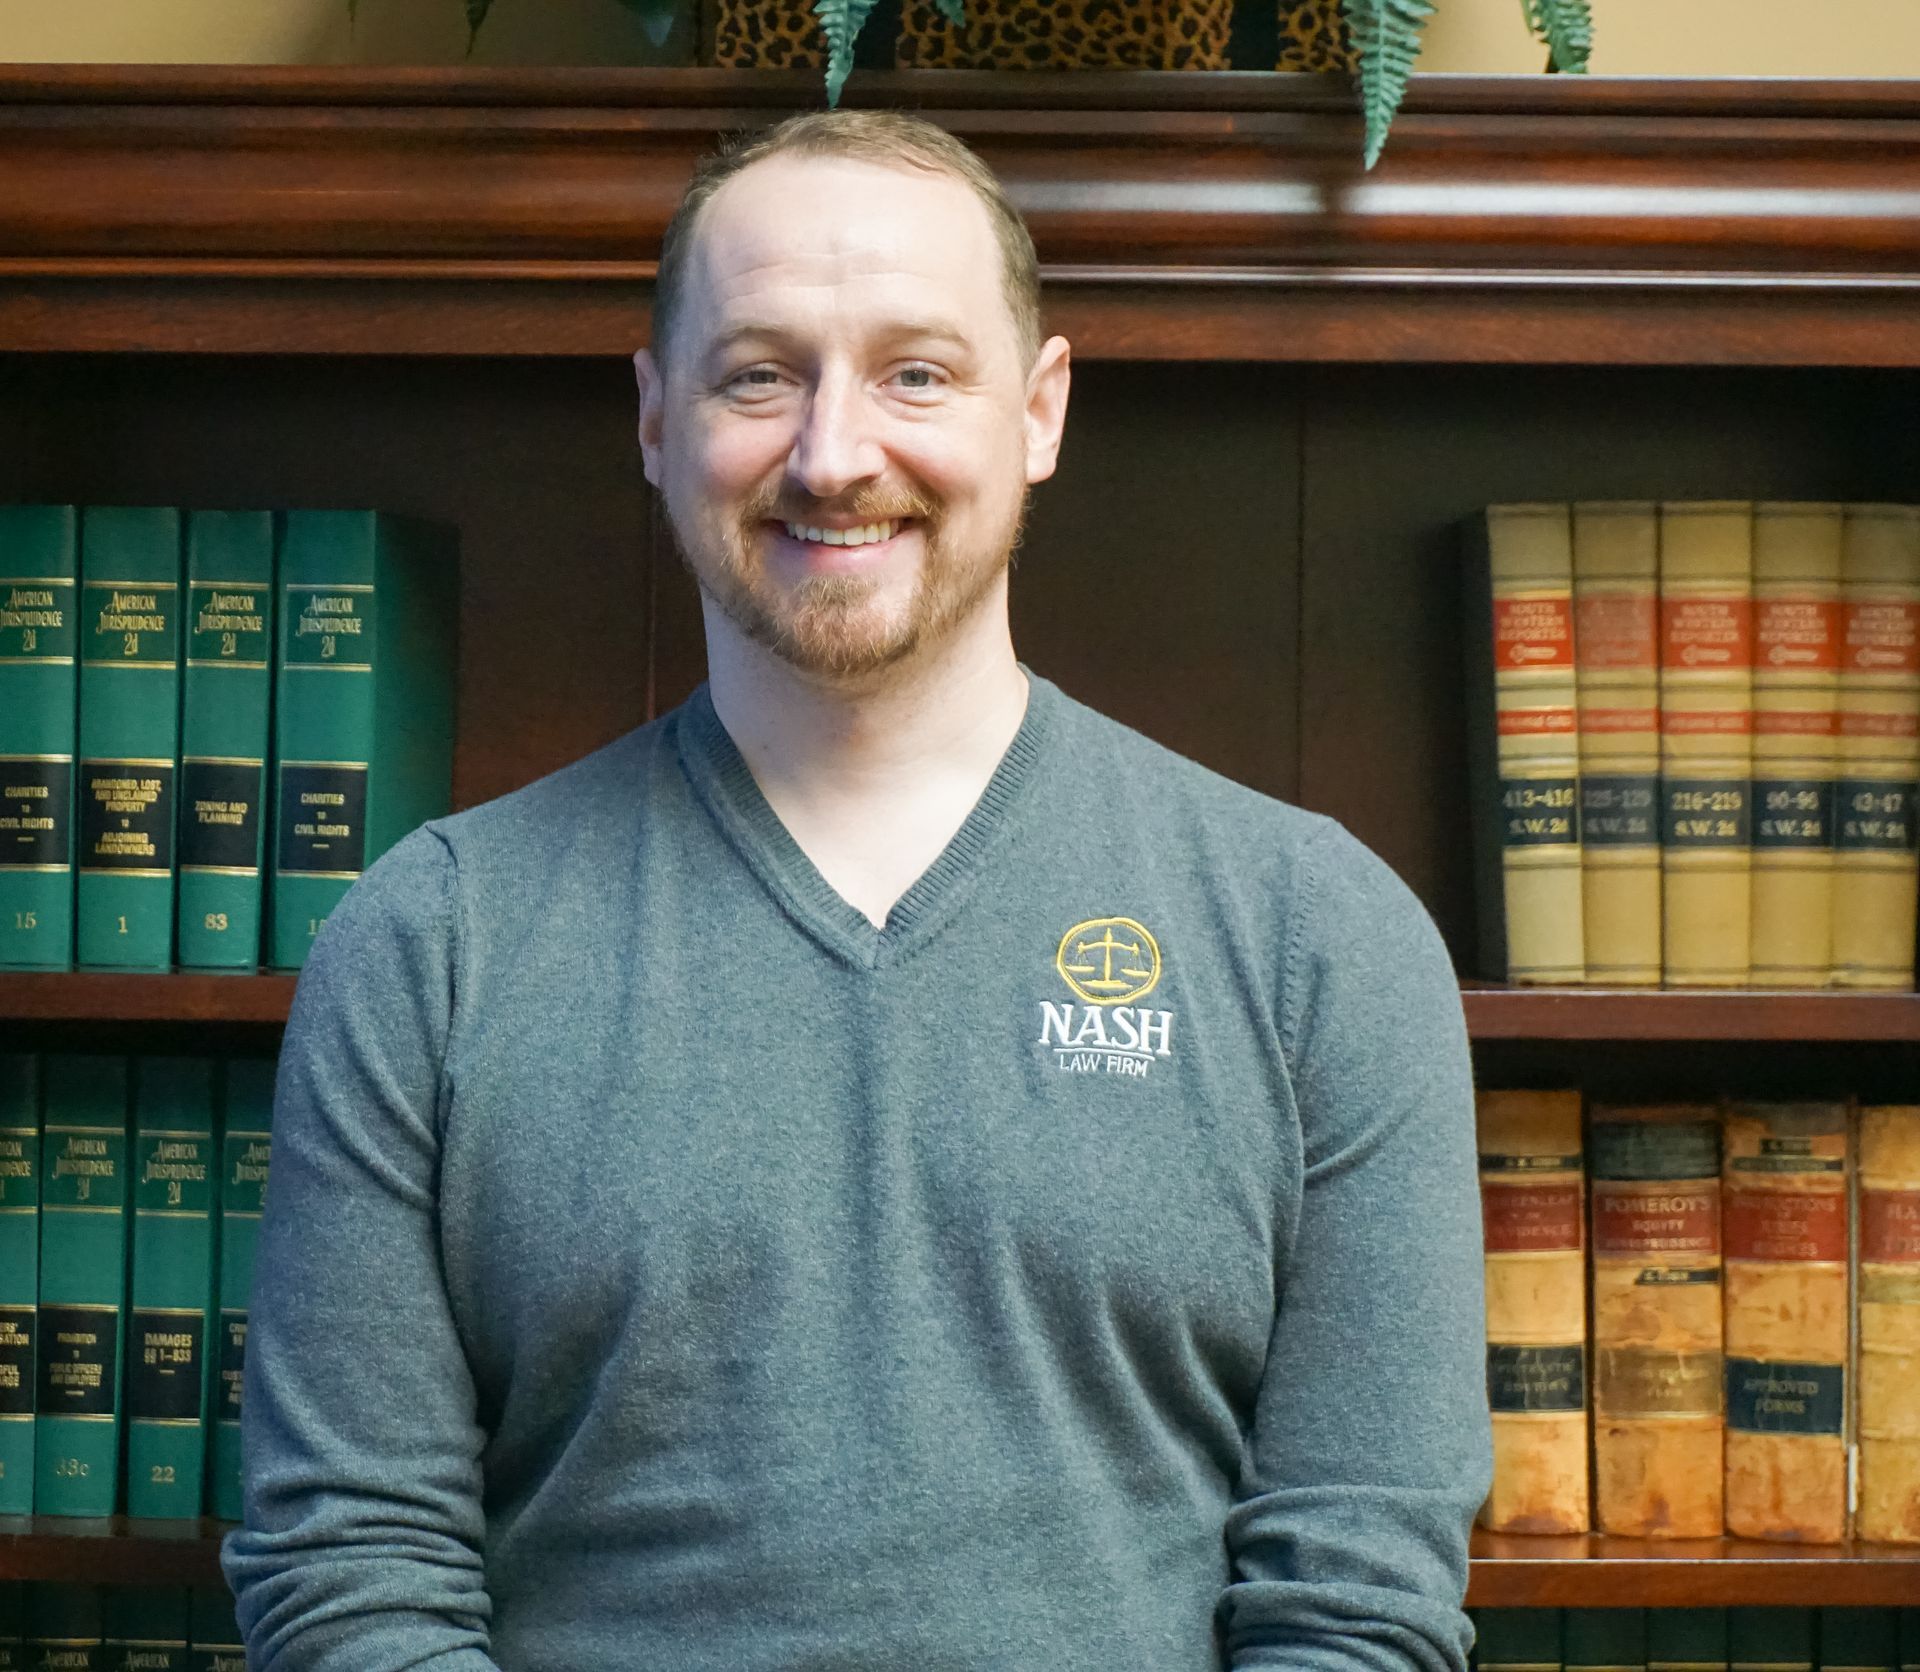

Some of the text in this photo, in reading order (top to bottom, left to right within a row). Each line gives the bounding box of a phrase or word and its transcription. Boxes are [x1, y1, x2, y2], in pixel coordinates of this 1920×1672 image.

[22, 817, 55, 830] RIGHTS
[317, 825, 350, 837] RIGHTS
[118, 916, 128, 933] 1
[205, 913, 228, 931] 83
[1037, 1000, 1174, 1056] NASH
[1060, 1053, 1149, 1079] LAW FIRM
[145, 1333, 193, 1348] DAMAGES
[151, 1466, 176, 1484] 22
